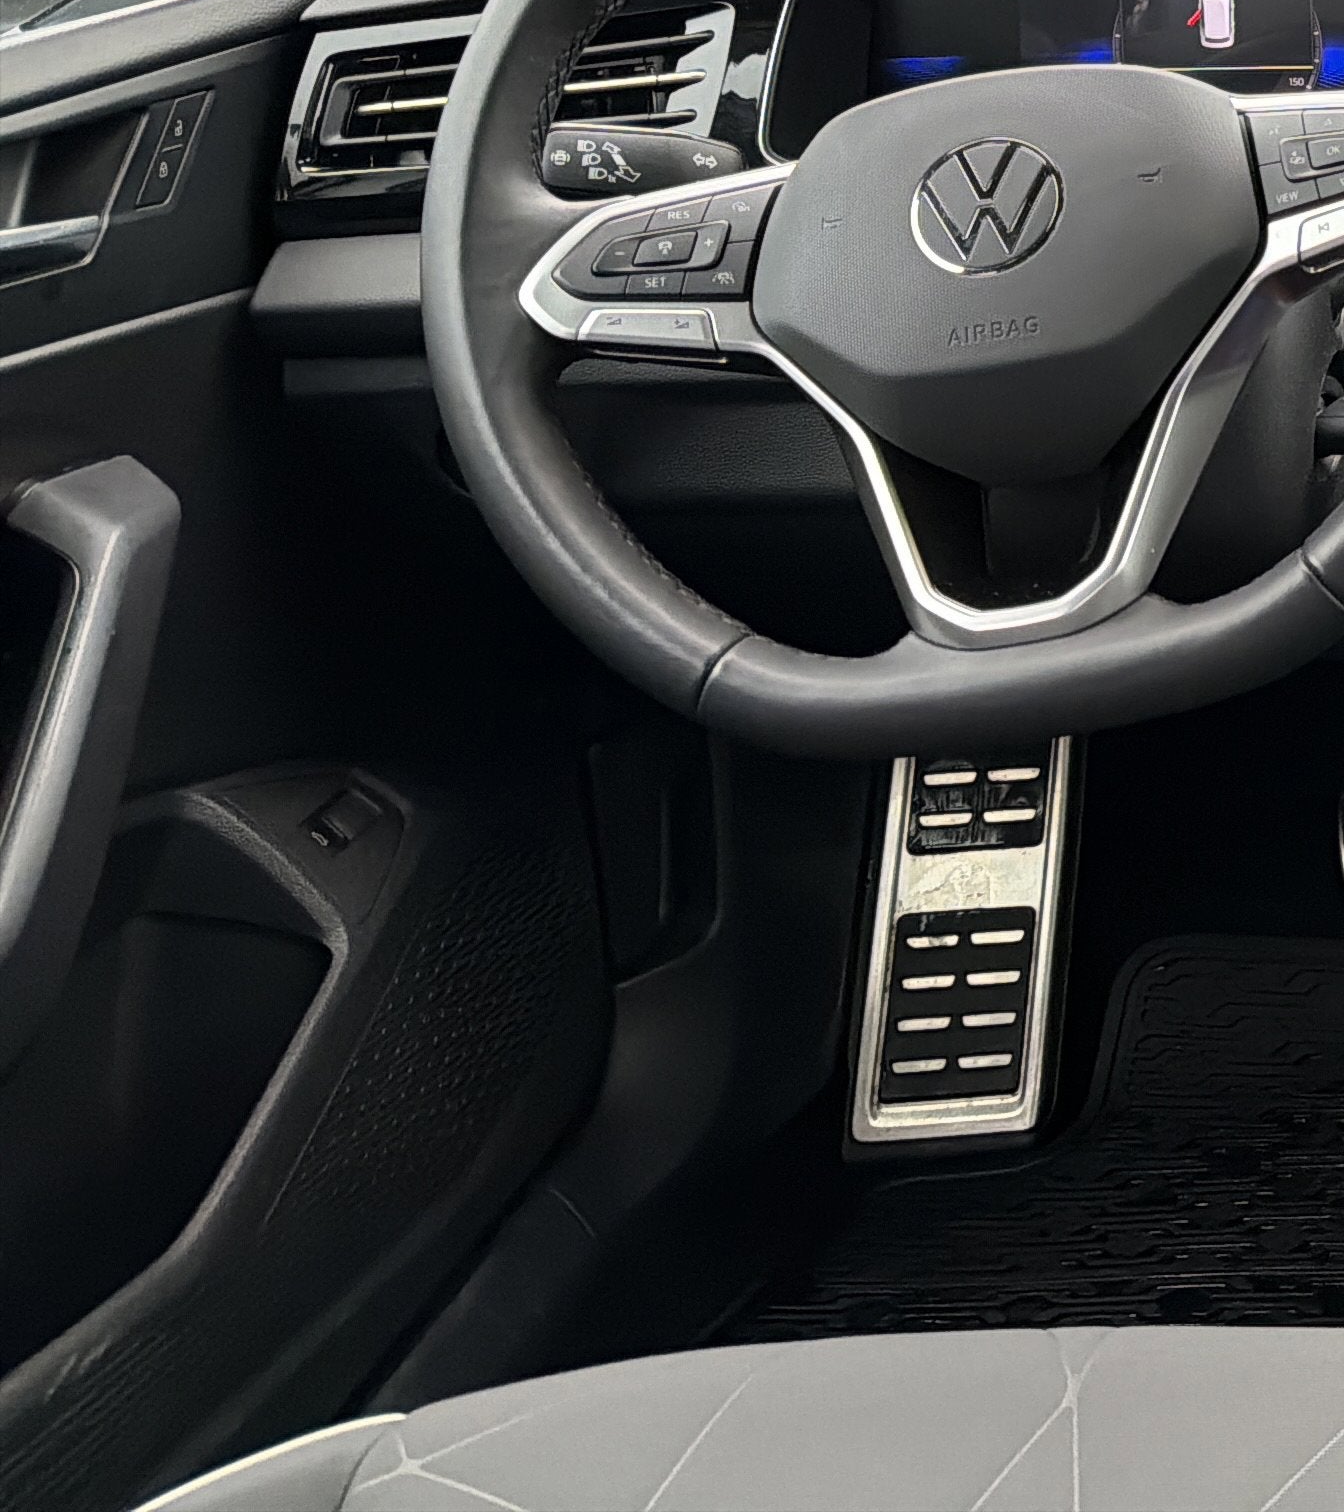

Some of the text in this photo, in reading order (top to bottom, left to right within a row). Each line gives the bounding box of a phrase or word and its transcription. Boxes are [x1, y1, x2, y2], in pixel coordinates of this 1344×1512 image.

[1326, 144, 1341, 156] OK
[1275, 190, 1300, 204] VIEW
[667, 210, 691, 220] RES
[644, 277, 666, 288] SET
[948, 315, 1041, 347] AIRBAG
